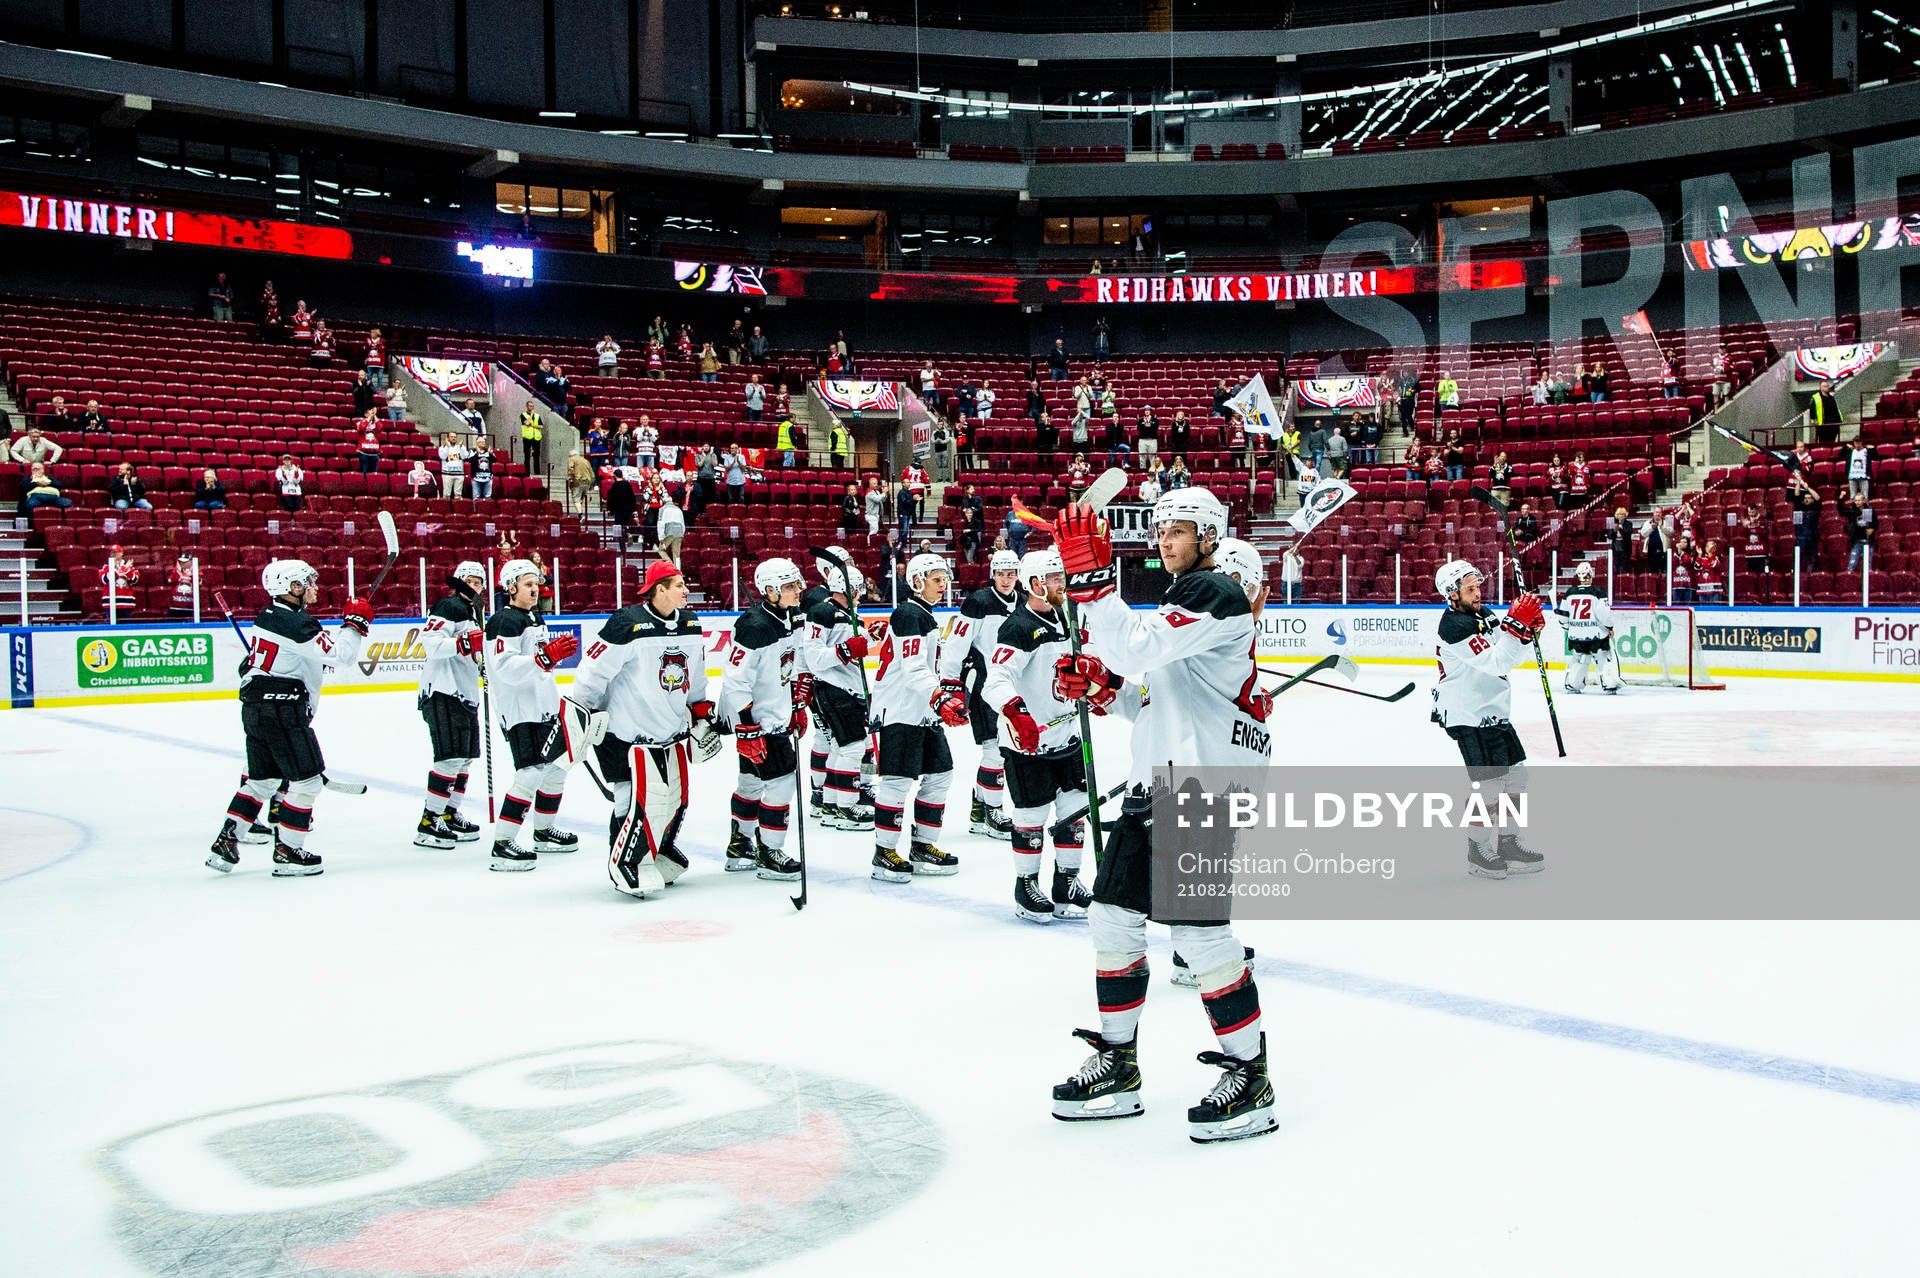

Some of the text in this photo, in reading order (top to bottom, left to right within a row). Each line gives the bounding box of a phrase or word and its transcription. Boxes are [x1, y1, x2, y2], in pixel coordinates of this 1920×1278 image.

[19, 195, 174, 241] VINNER!
[1097, 271, 1377, 303] REDHAWKS VINNER!
[1571, 599, 1592, 620] 72
[954, 620, 970, 638] 14
[1353, 618, 1420, 632] OBEROENDE
[122, 638, 208, 657] GASAB
[903, 639, 921, 659] 58
[1468, 634, 1491, 656] 65
[14, 634, 28, 694] CCM
[122, 655, 208, 668] INBROTTSSKYDD
[729, 645, 746, 667] 12
[378, 663, 425, 672] KANALEN
[90, 674, 203, 687] Christers Montage AB
[263, 692, 301, 701] CCM
[624, 818, 644, 863] CCM
[1093, 1079, 1116, 1093] CCM
